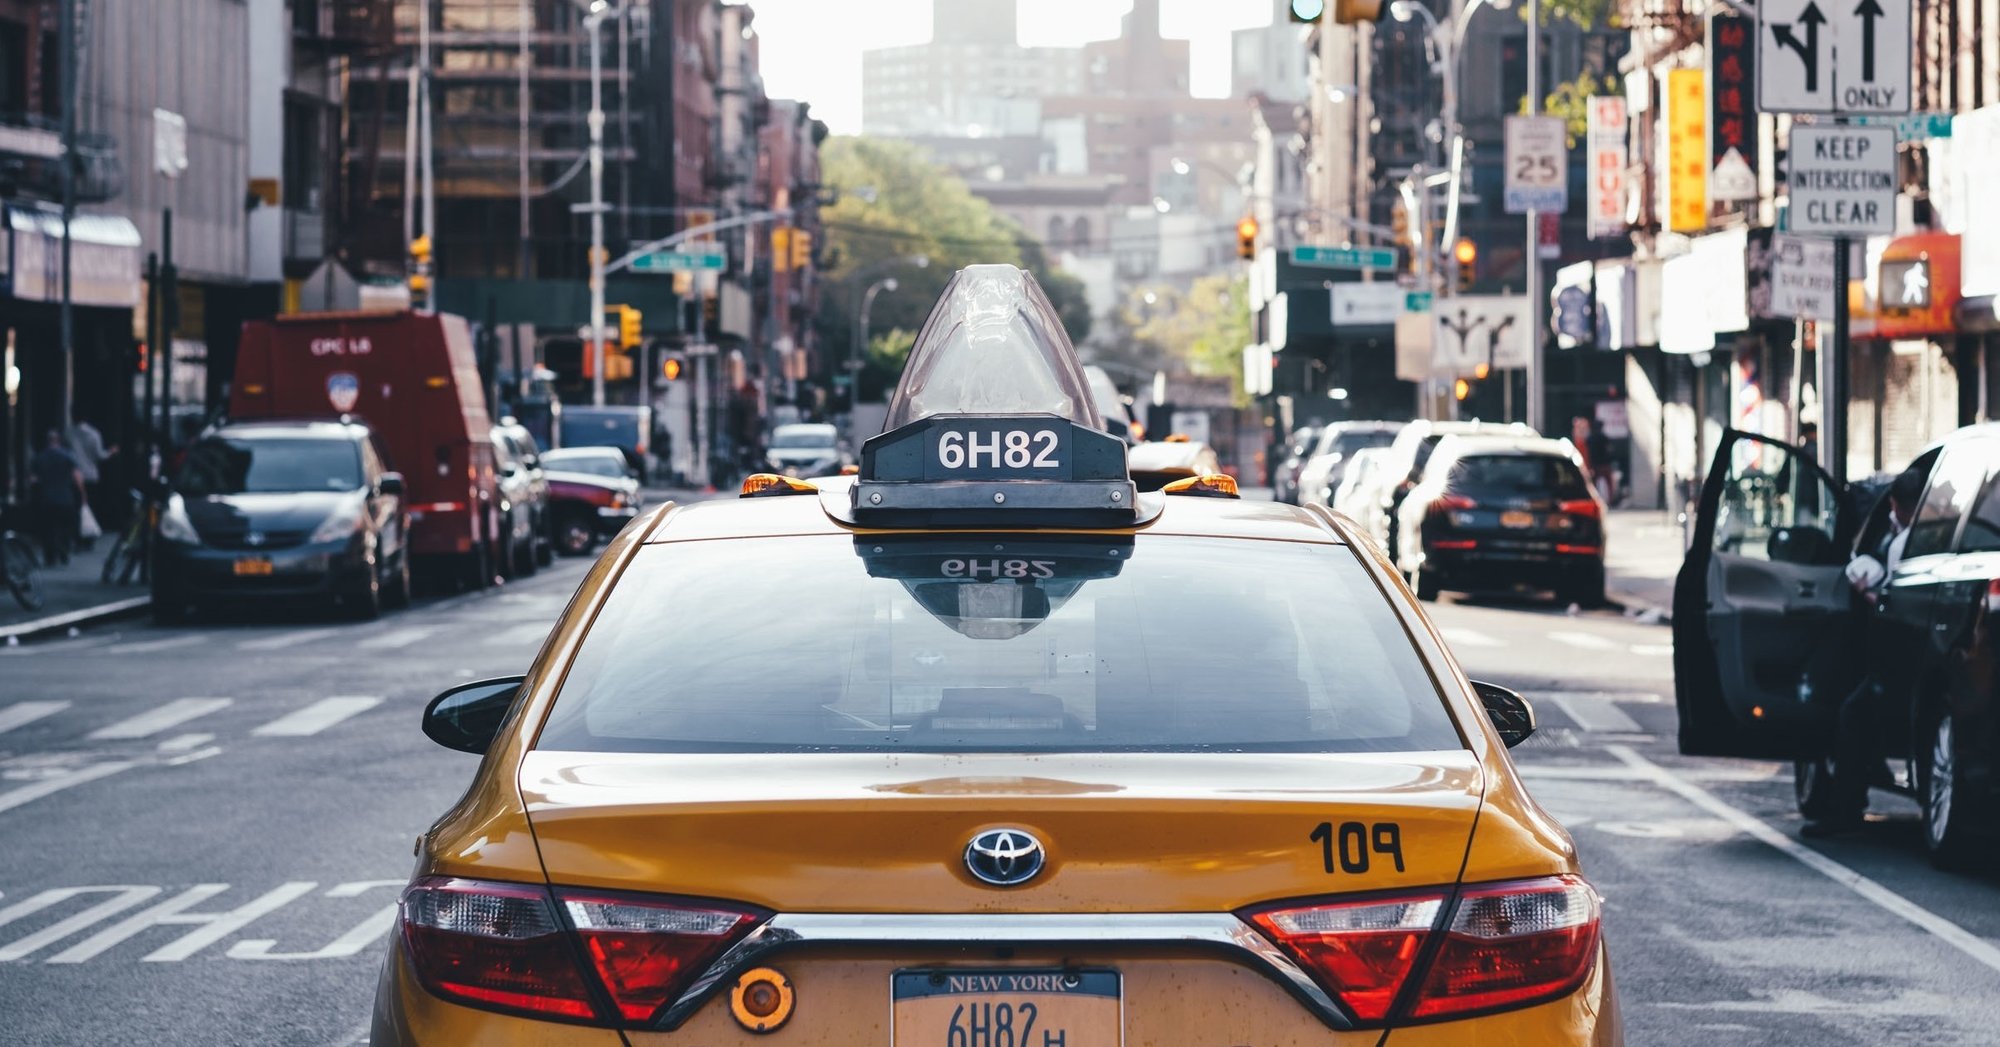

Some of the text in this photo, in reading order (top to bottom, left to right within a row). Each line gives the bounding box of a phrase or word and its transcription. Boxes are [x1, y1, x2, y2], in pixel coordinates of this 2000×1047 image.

[1845, 87, 1896, 107] ONLY
[1815, 136, 1871, 161] KEEP
[1516, 155, 1558, 182] 25
[1793, 169, 1892, 190] INTERSECTION
[1599, 152, 1618, 215] BUS
[1807, 200, 1878, 224] CLEAR
[938, 430, 1060, 468] 6H82
[1309, 821, 1405, 874] 109
[950, 975, 1067, 993] NEW YORK
[947, 1002, 1038, 1047] 6H82
